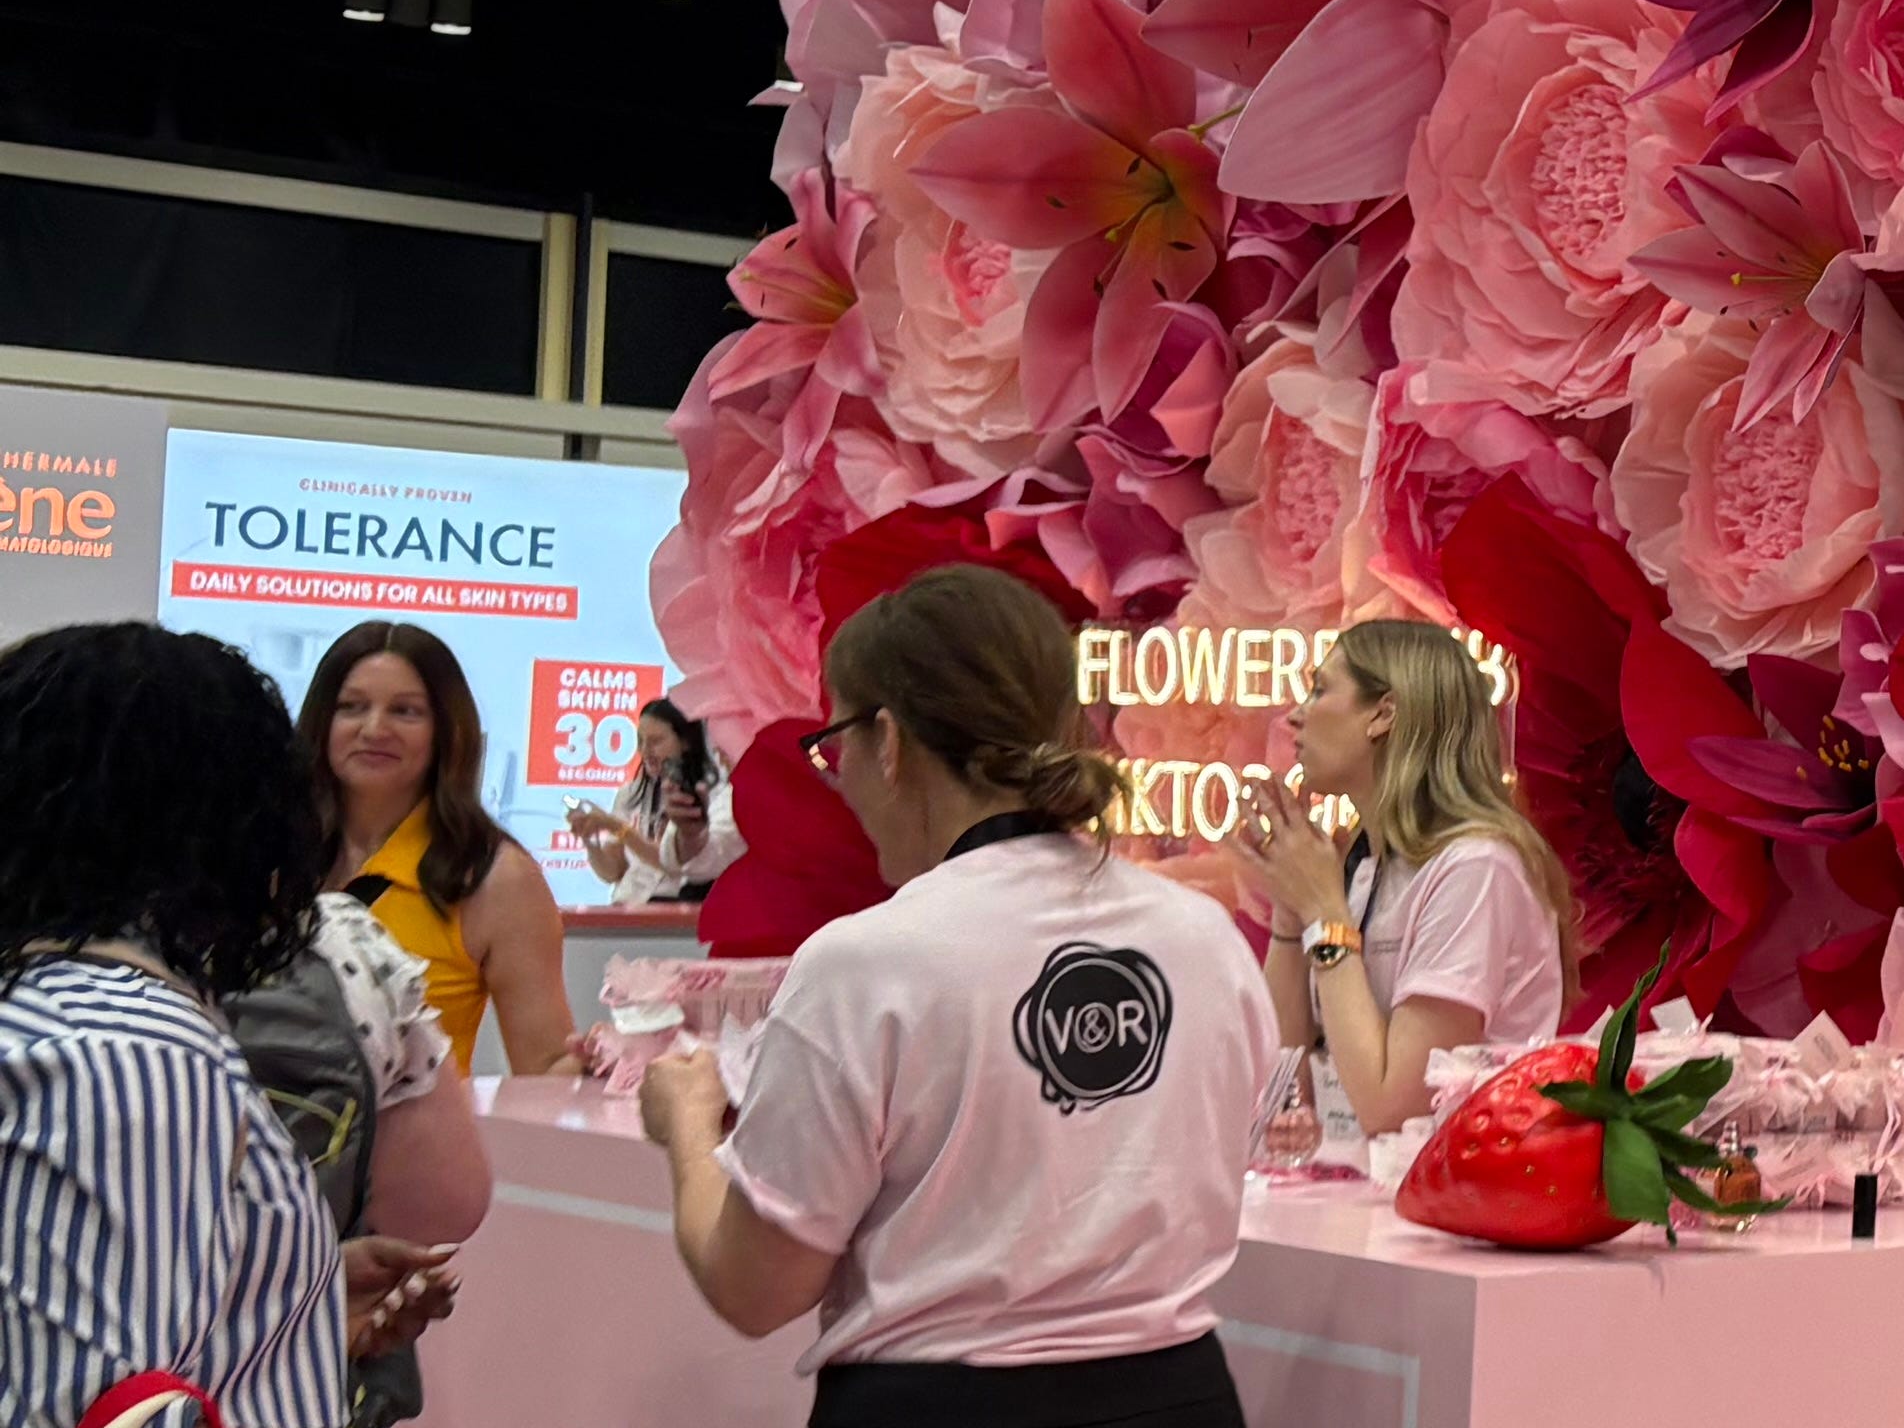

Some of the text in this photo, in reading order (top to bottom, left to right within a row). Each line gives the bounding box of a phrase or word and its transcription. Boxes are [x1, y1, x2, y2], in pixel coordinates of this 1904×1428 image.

[3, 451, 118, 477] HERMALE
[403, 486, 473, 504] PROVEN
[205, 501, 556, 569] TOLERANCE
[190, 570, 568, 613] DAILY SOLUTIONS FOR ALL SKIN TYPES
[559, 667, 638, 690] CALMS
[557, 689, 639, 712] SKIN IN
[554, 712, 638, 768] 30
[1045, 1000, 1148, 1054] V&R
